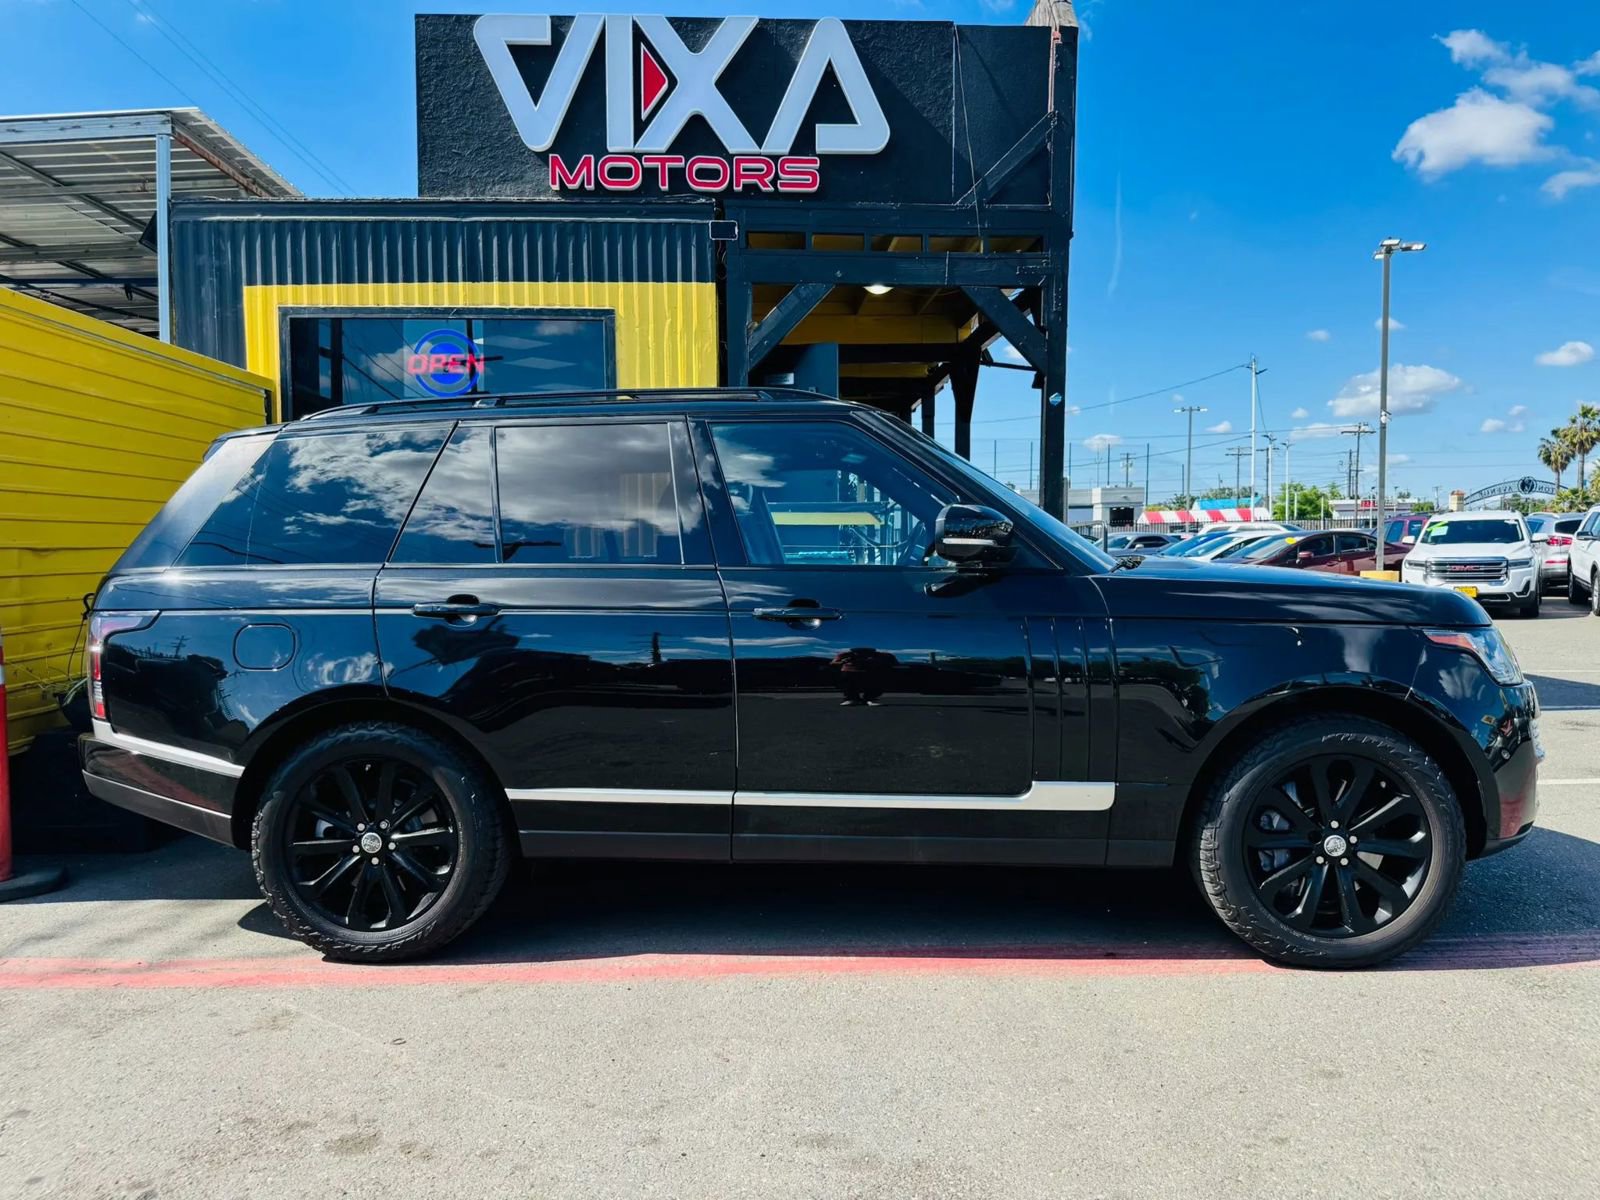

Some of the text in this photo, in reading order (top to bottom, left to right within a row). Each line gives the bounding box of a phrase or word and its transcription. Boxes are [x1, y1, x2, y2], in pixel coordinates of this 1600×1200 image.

[473, 13, 890, 155] VIXA
[548, 153, 820, 193] MOTORS
[407, 353, 485, 375] OPEN
